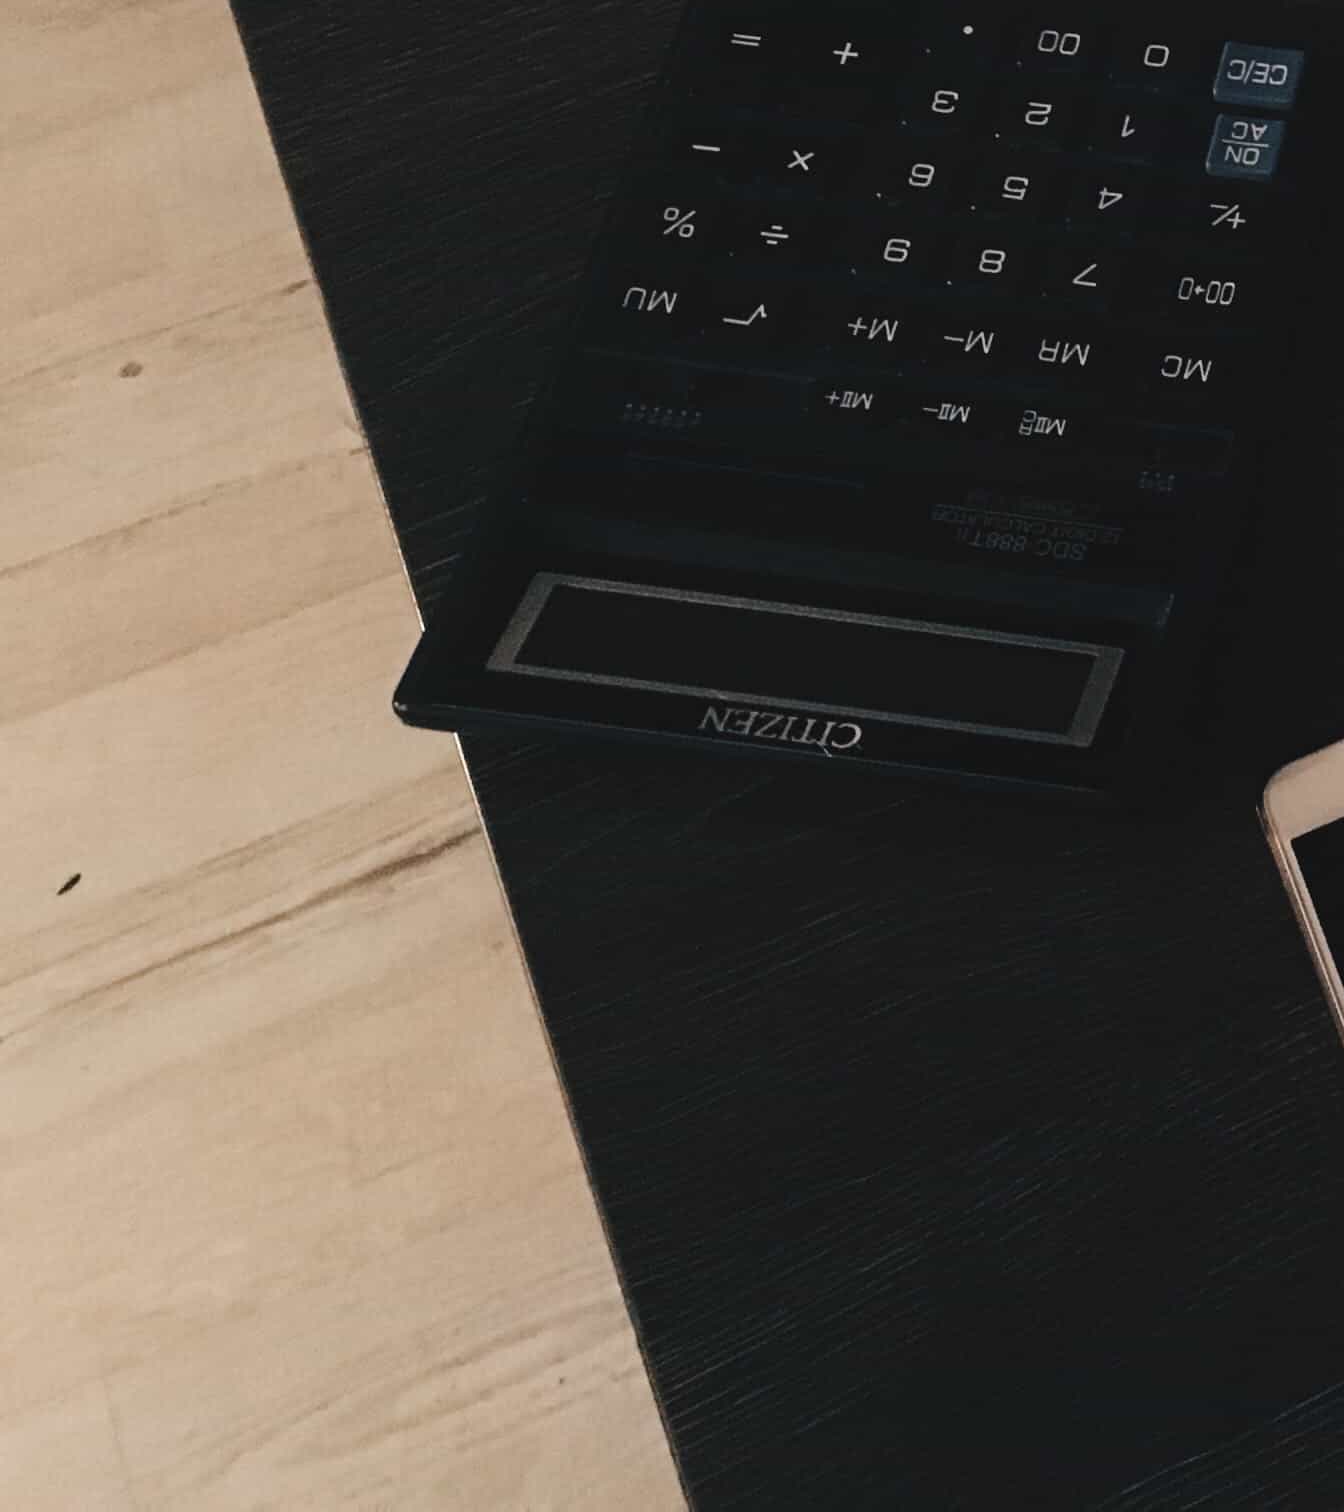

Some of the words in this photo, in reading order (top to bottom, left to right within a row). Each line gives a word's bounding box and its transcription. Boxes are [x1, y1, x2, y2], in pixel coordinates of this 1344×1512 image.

[1038, 30, 1080, 55] 00
[1144, 45, 1169, 67] 0
[1223, 56, 1287, 85] CE/C
[932, 91, 958, 113] 3
[1025, 102, 1052, 125] 2
[1122, 116, 1134, 137] 1
[1228, 122, 1267, 142] AC
[1225, 144, 1262, 165] ON
[909, 164, 934, 187] 6
[1003, 177, 1028, 200] 5
[1098, 188, 1123, 209] 4
[884, 239, 910, 262] 9
[979, 250, 1005, 273] 8
[1073, 264, 1096, 286] 7
[623, 287, 677, 313] MU
[848, 318, 898, 341] M+
[1039, 340, 1090, 365] MR
[1161, 356, 1211, 382] MC
[697, 705, 865, 751] CITIZEN
